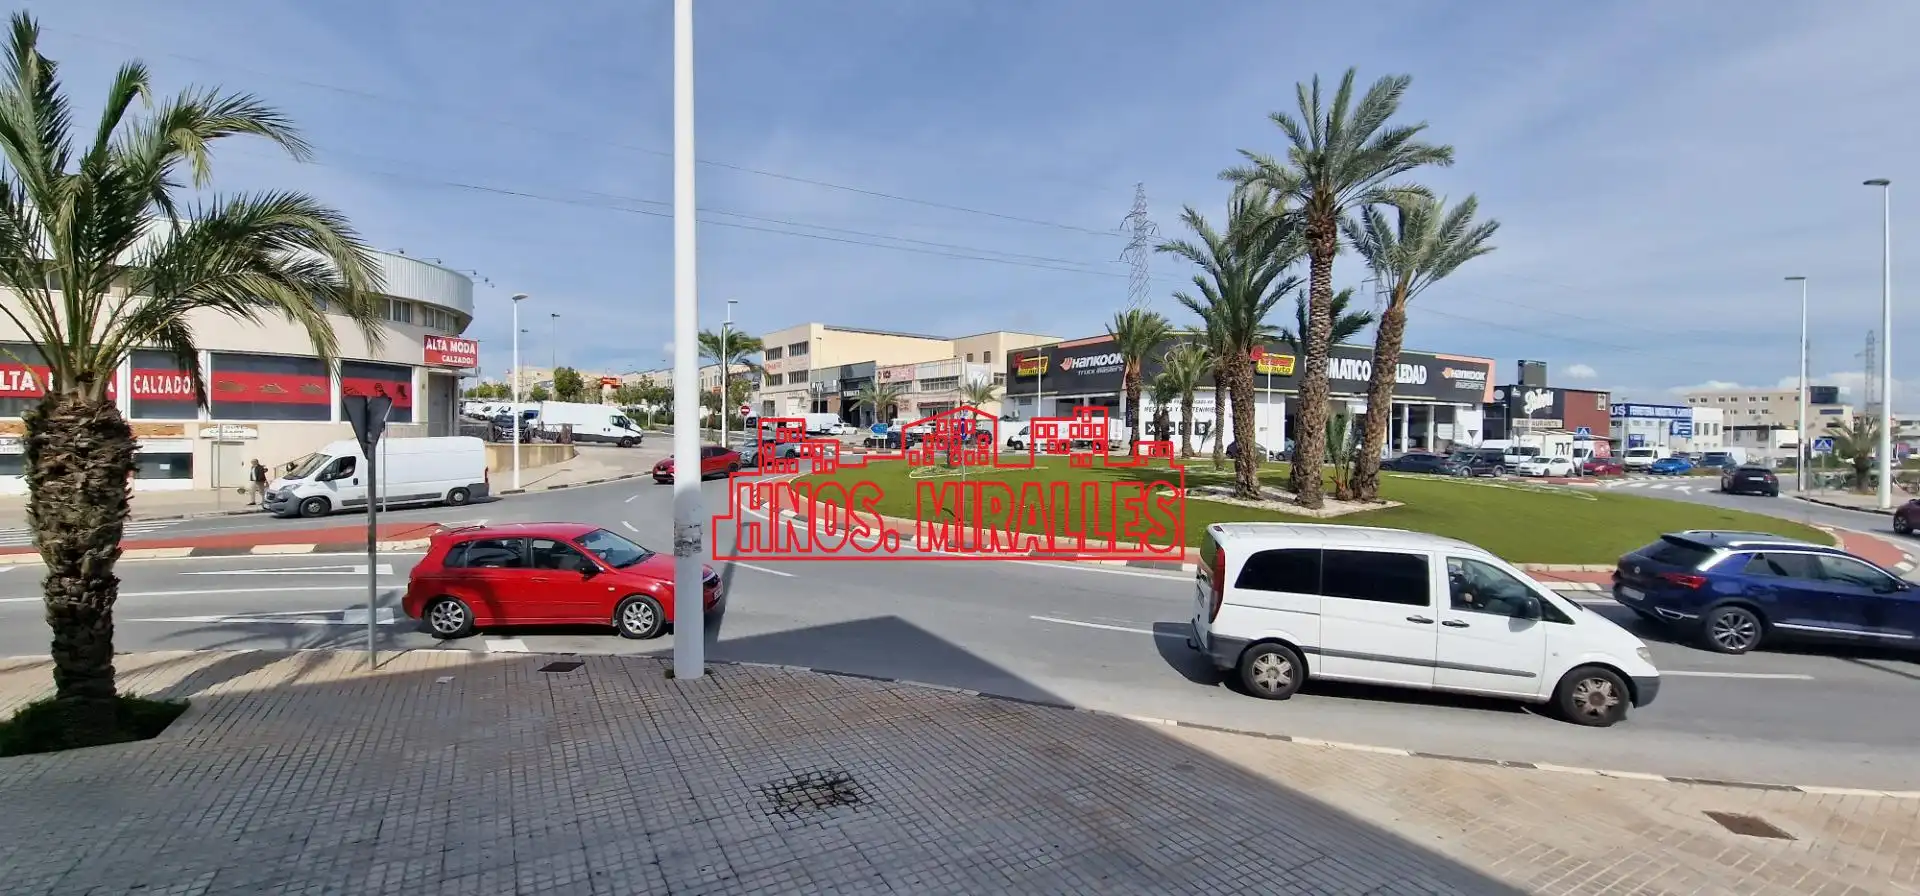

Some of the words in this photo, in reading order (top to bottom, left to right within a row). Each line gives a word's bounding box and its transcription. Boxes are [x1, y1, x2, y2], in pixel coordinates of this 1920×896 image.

[426, 338, 448, 351] ALTA
[450, 341, 476, 354] MODA
[441, 355, 474, 364] CALZADOS
[0, 370, 36, 391] LTA
[1395, 363, 1427, 385] LEDAD
[133, 374, 197, 394] CALZADO
[1554, 442, 1572, 456] TXT
